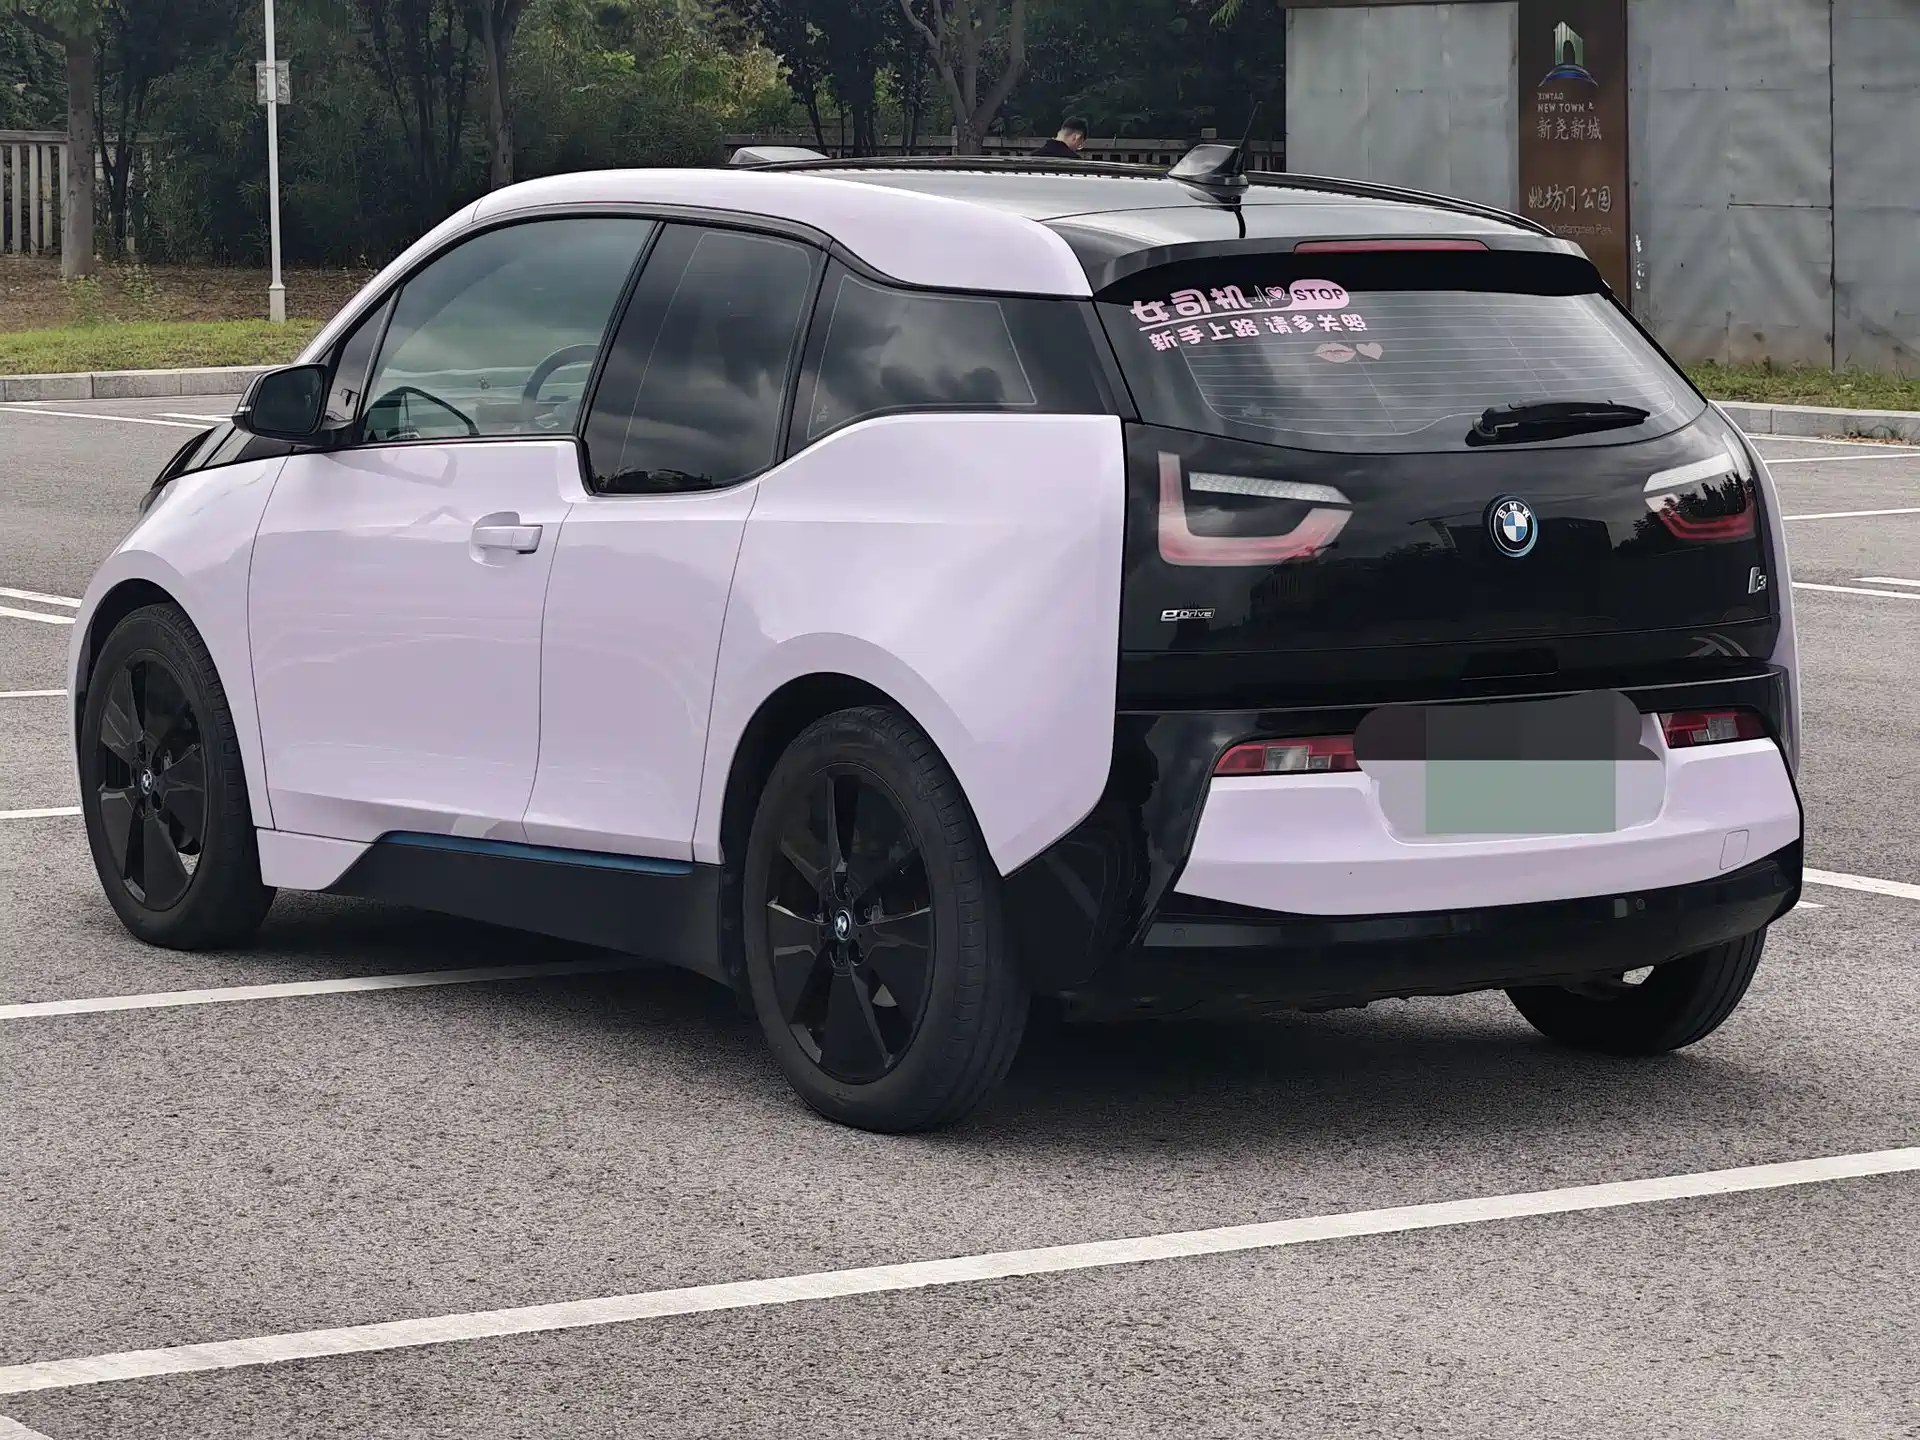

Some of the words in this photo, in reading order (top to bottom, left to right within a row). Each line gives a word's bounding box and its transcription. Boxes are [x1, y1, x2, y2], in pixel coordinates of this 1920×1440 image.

[1537, 103, 1556, 113] NEW
[1559, 103, 1585, 113] TOWN
[1537, 116, 1602, 140] 新尧新城
[1130, 285, 1253, 324] 女司机
[1293, 288, 1344, 302] STOP
[1149, 318, 1260, 351] 新手上路
[1264, 314, 1367, 335] 请多关照
[1498, 503, 1531, 519] BMW
